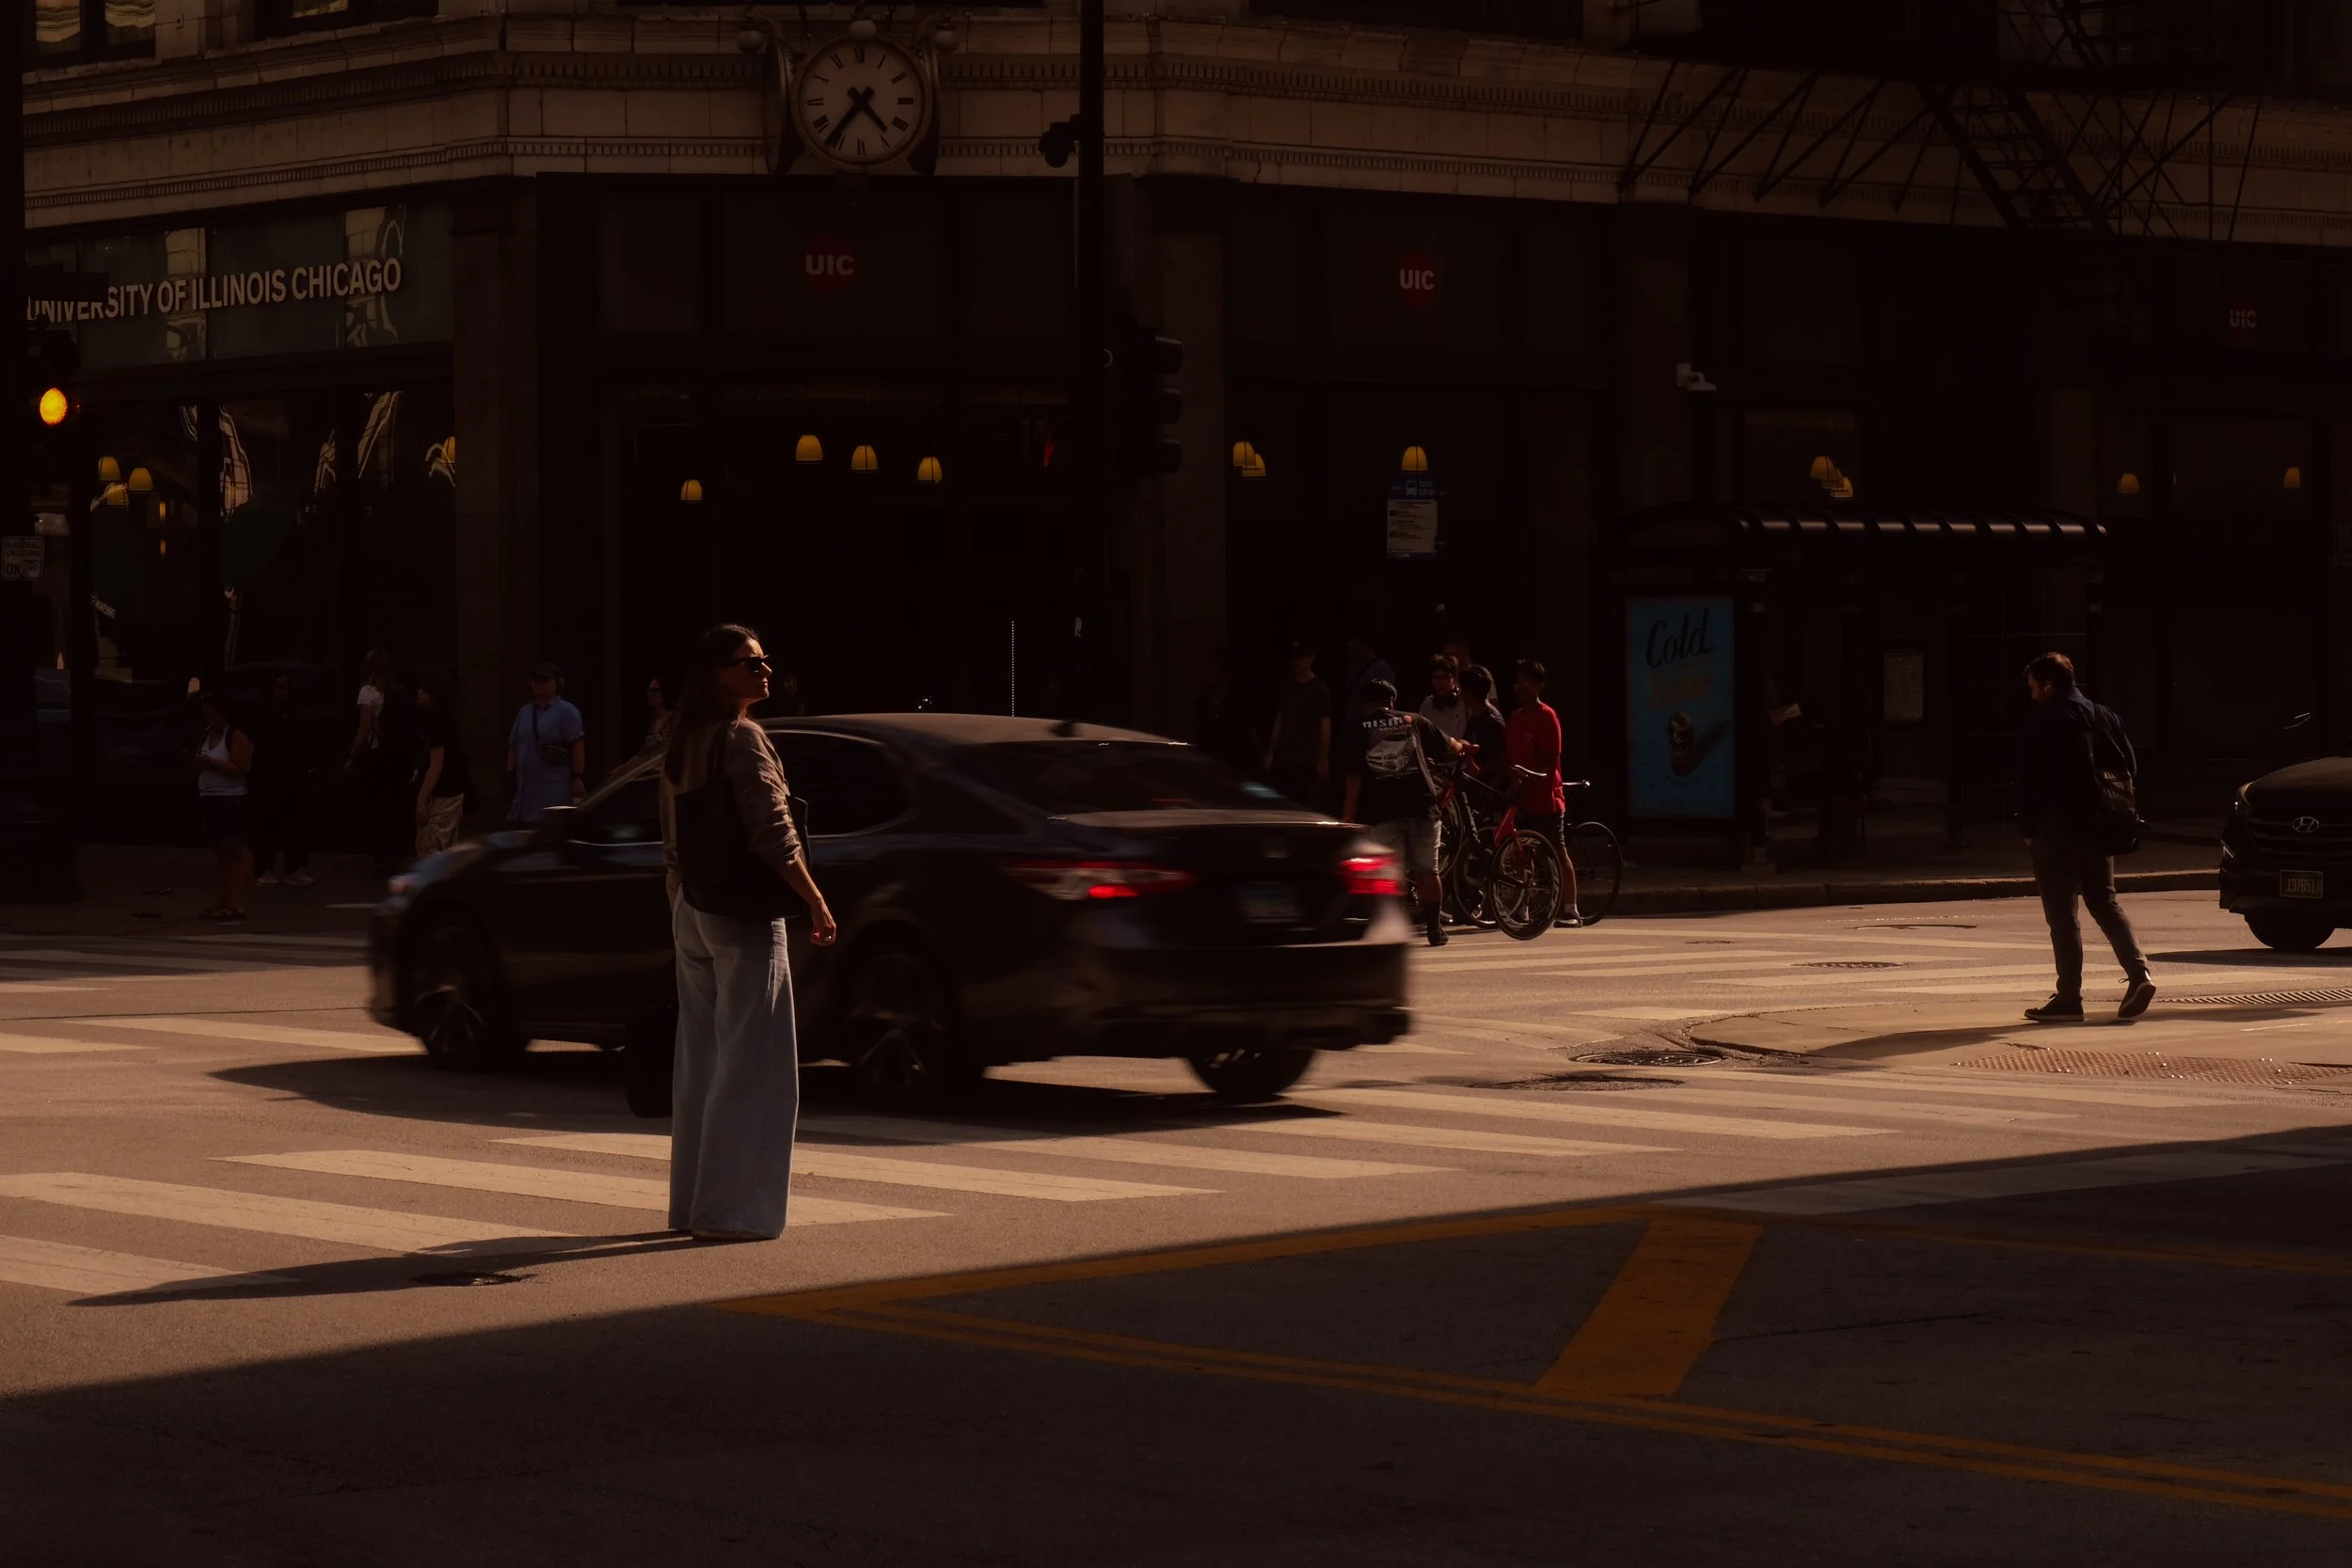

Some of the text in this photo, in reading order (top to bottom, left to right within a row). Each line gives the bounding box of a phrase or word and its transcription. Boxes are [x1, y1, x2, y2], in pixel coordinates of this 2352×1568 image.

[805, 254, 855, 276] UIC
[26, 257, 402, 324] UNIVERSITY OF ILLINOIS CHICAGO
[1400, 269, 1436, 291] UIC
[2229, 309, 2257, 328] UIC
[5, 563, 23, 577] OK
[1646, 607, 1715, 669] Cold
